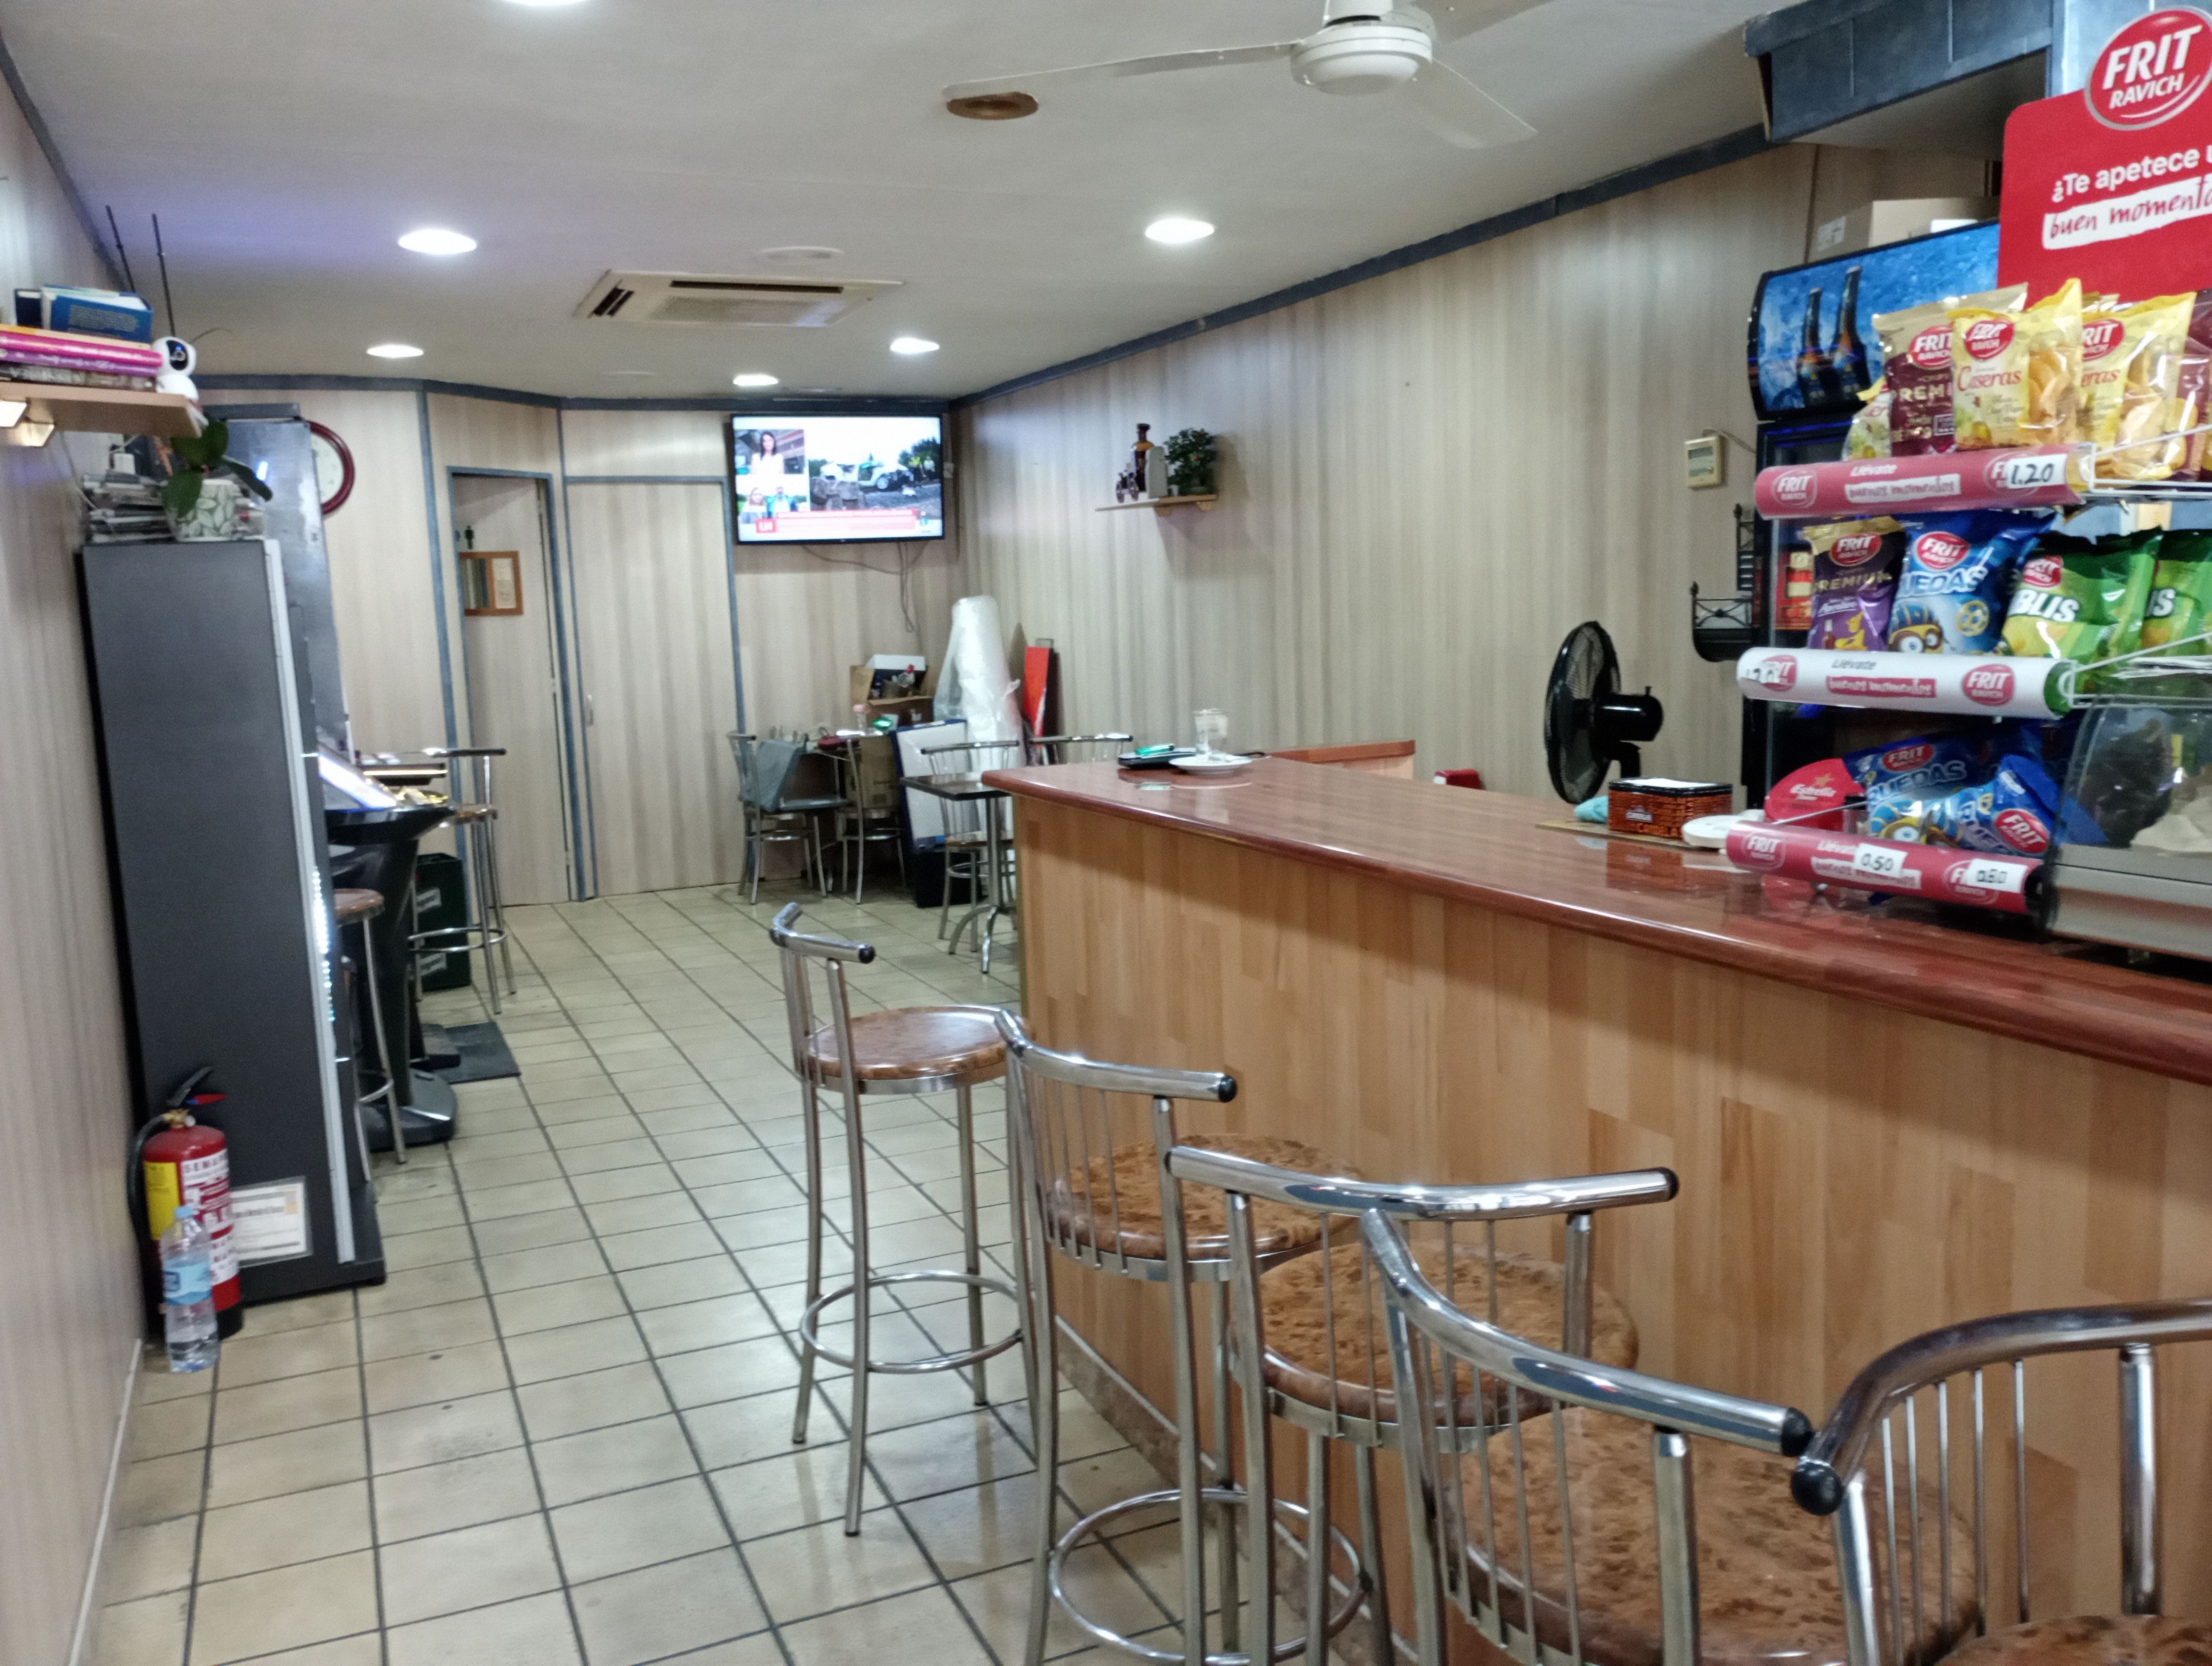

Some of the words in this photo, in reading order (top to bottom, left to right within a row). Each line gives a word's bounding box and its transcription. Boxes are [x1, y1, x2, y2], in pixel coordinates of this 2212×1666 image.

[2102, 24, 2202, 90] FRIT
[2109, 73, 2184, 109] RAVICH
[2051, 173, 2090, 203] ¿Te
[2095, 148, 2200, 191] apetece
[2050, 215, 2098, 239] buen
[2083, 323, 2119, 344] RIT
[1957, 366, 2022, 392] Caseras
[2081, 369, 2119, 387] eras
[1777, 475, 1814, 493] FRIT
[2012, 463, 2054, 485] 1.20
[1836, 535, 1875, 553] FRIT
[1921, 537, 1964, 558] FRIT
[1967, 671, 2010, 690] FRIT
[1888, 746, 1925, 764] FRIT
[2002, 814, 2046, 844] FRIT
[1746, 836, 1782, 853] FRIT
